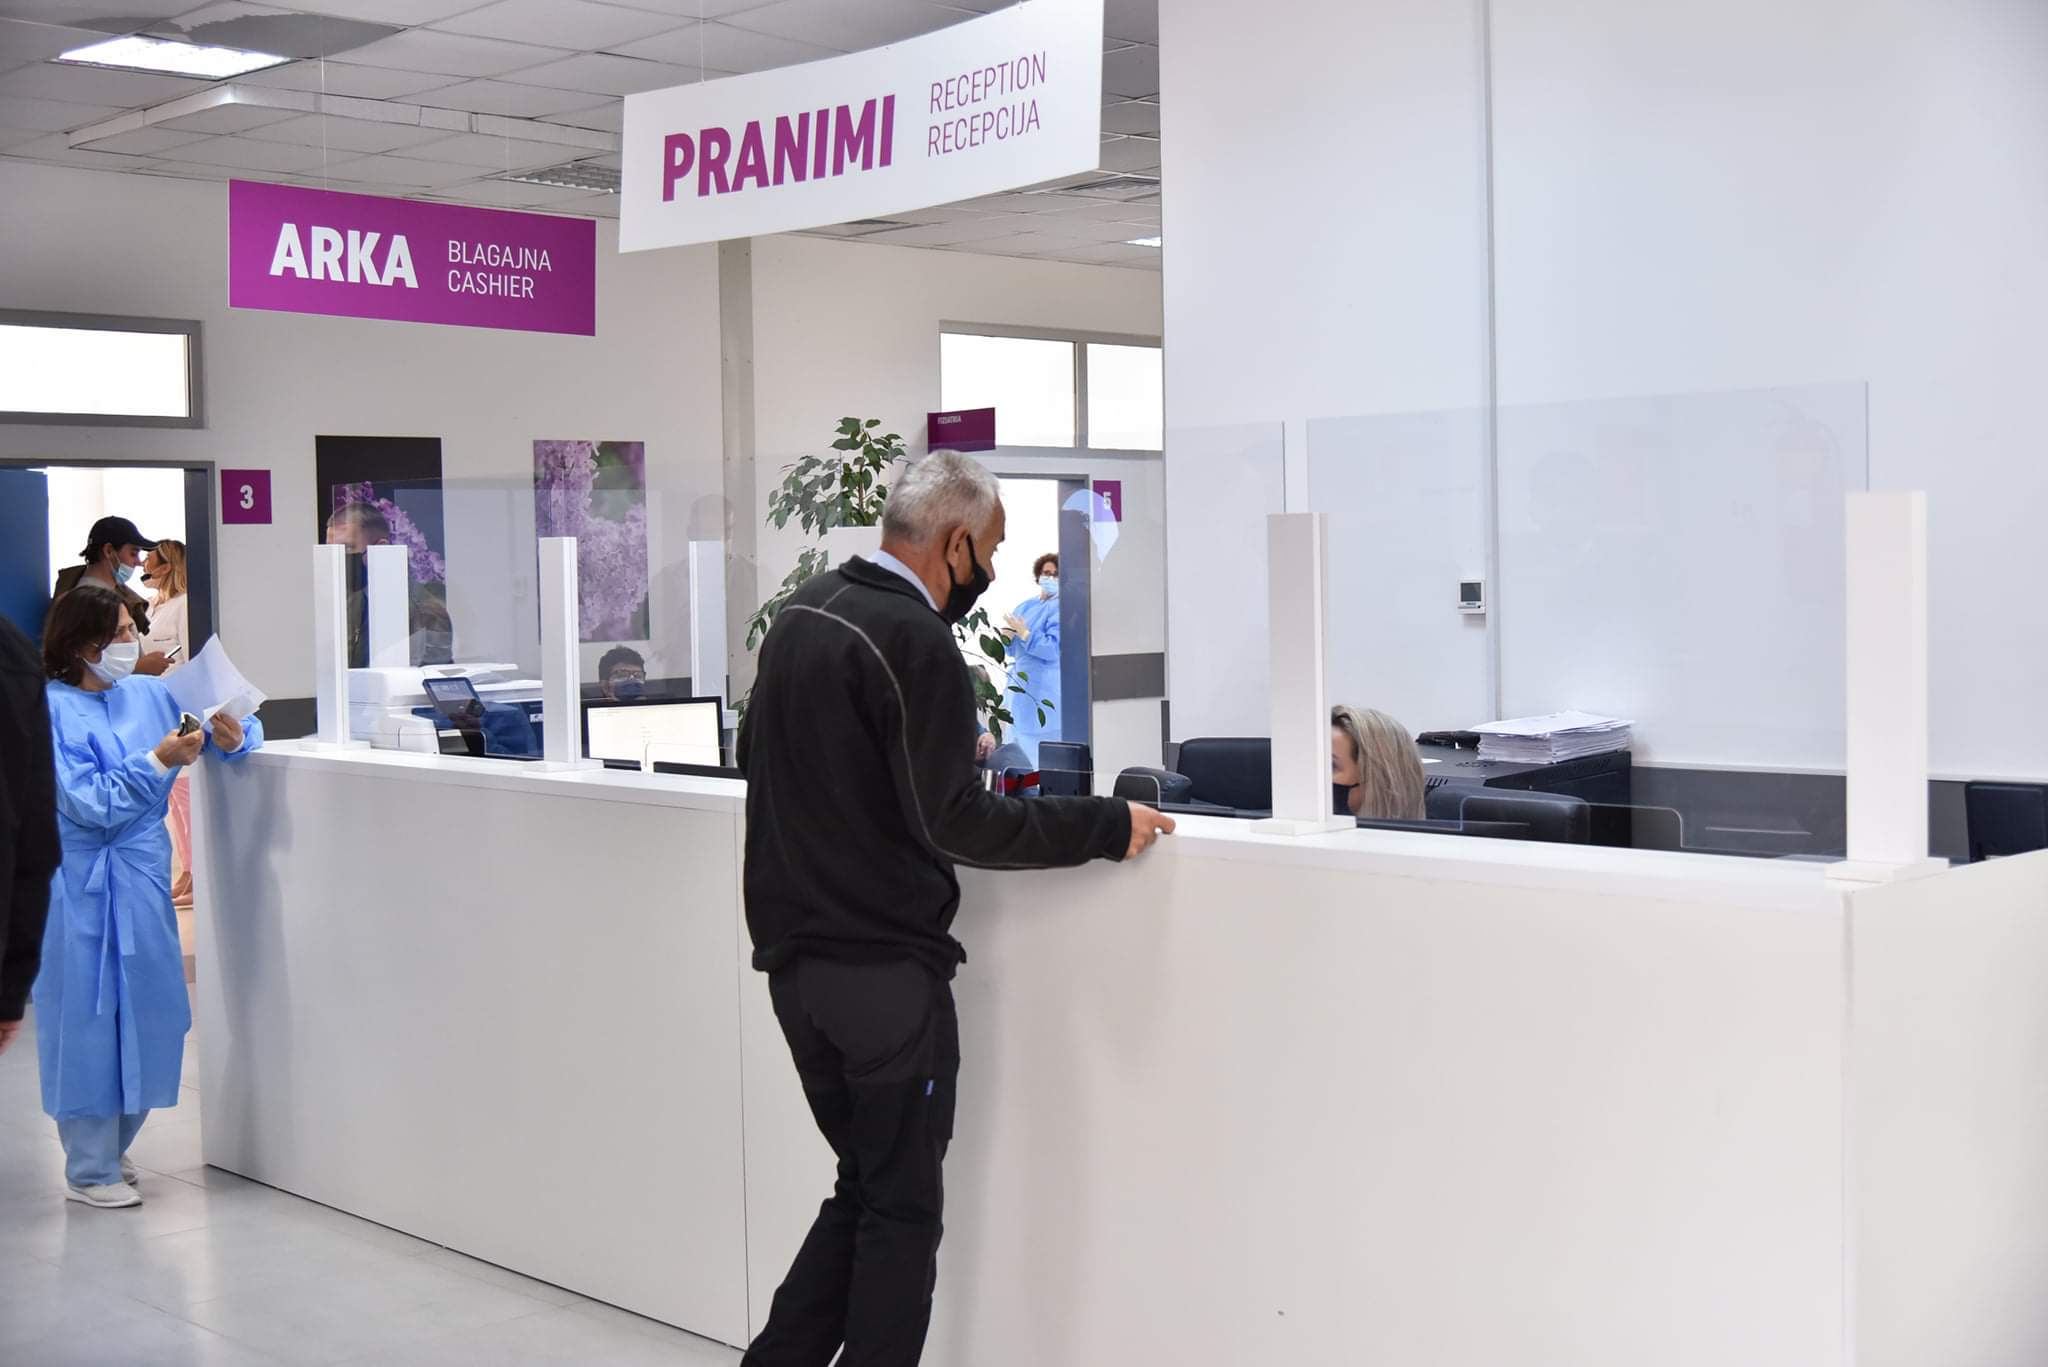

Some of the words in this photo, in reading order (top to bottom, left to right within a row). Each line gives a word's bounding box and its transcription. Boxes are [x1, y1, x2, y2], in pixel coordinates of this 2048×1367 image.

[930, 51, 1046, 114] RECEPTION
[663, 95, 895, 202] PRANIMI
[928, 99, 1040, 157] RECEPCIJA
[269, 222, 418, 288] ARKA
[448, 240, 552, 272] BLAGAJNA
[448, 270, 534, 299] CASHIER
[240, 485, 254, 510] 3
